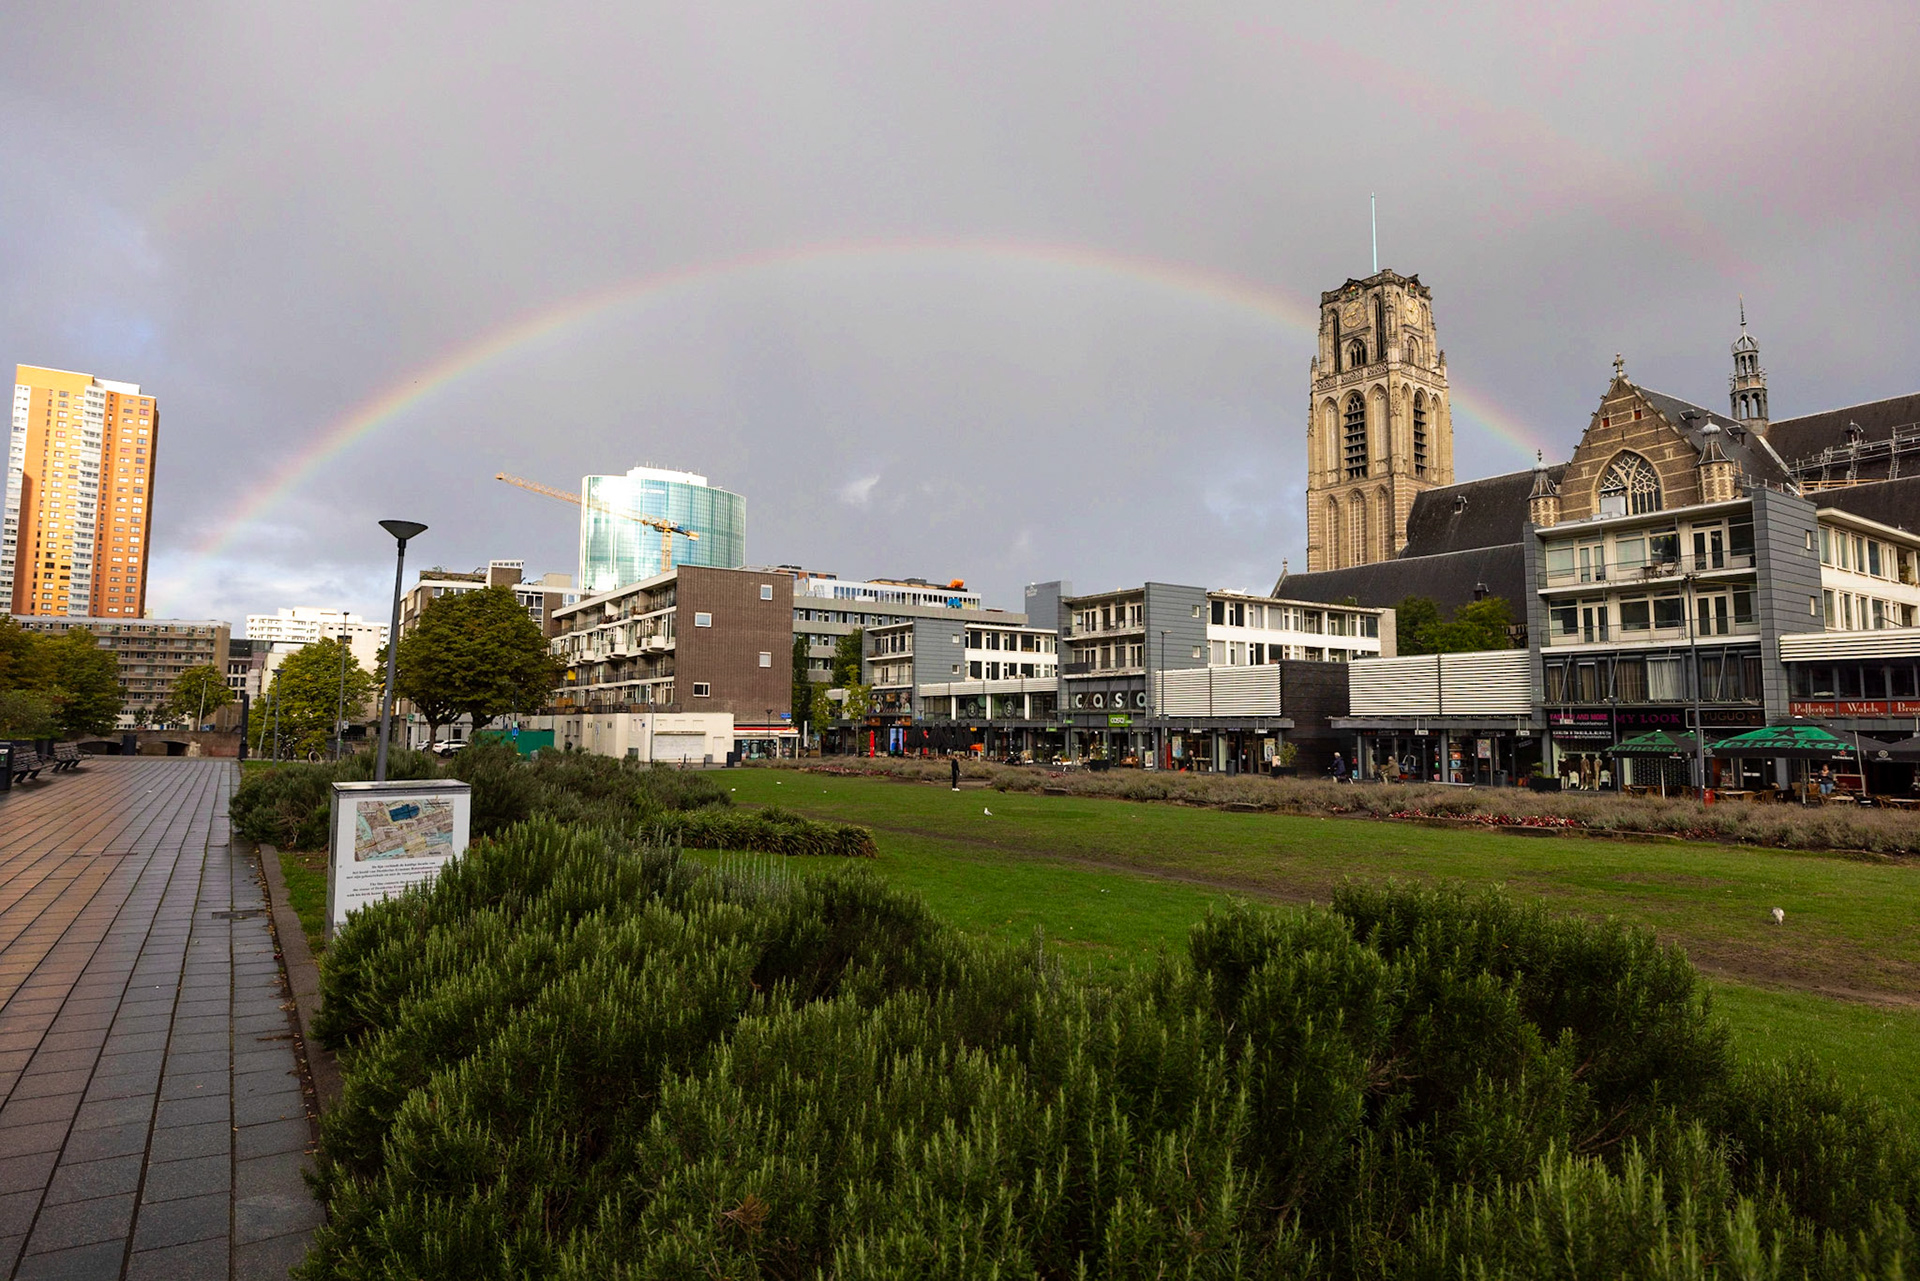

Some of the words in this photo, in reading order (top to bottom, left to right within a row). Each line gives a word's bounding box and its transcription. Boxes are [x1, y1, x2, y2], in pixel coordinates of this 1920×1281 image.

[1794, 702, 1835, 714] Poffertjes
[1847, 702, 1879, 713] Wafels
[1614, 713, 1636, 724] MY
[1639, 713, 1681, 724] LOOK
[1703, 711, 1746, 721] YUGUO
